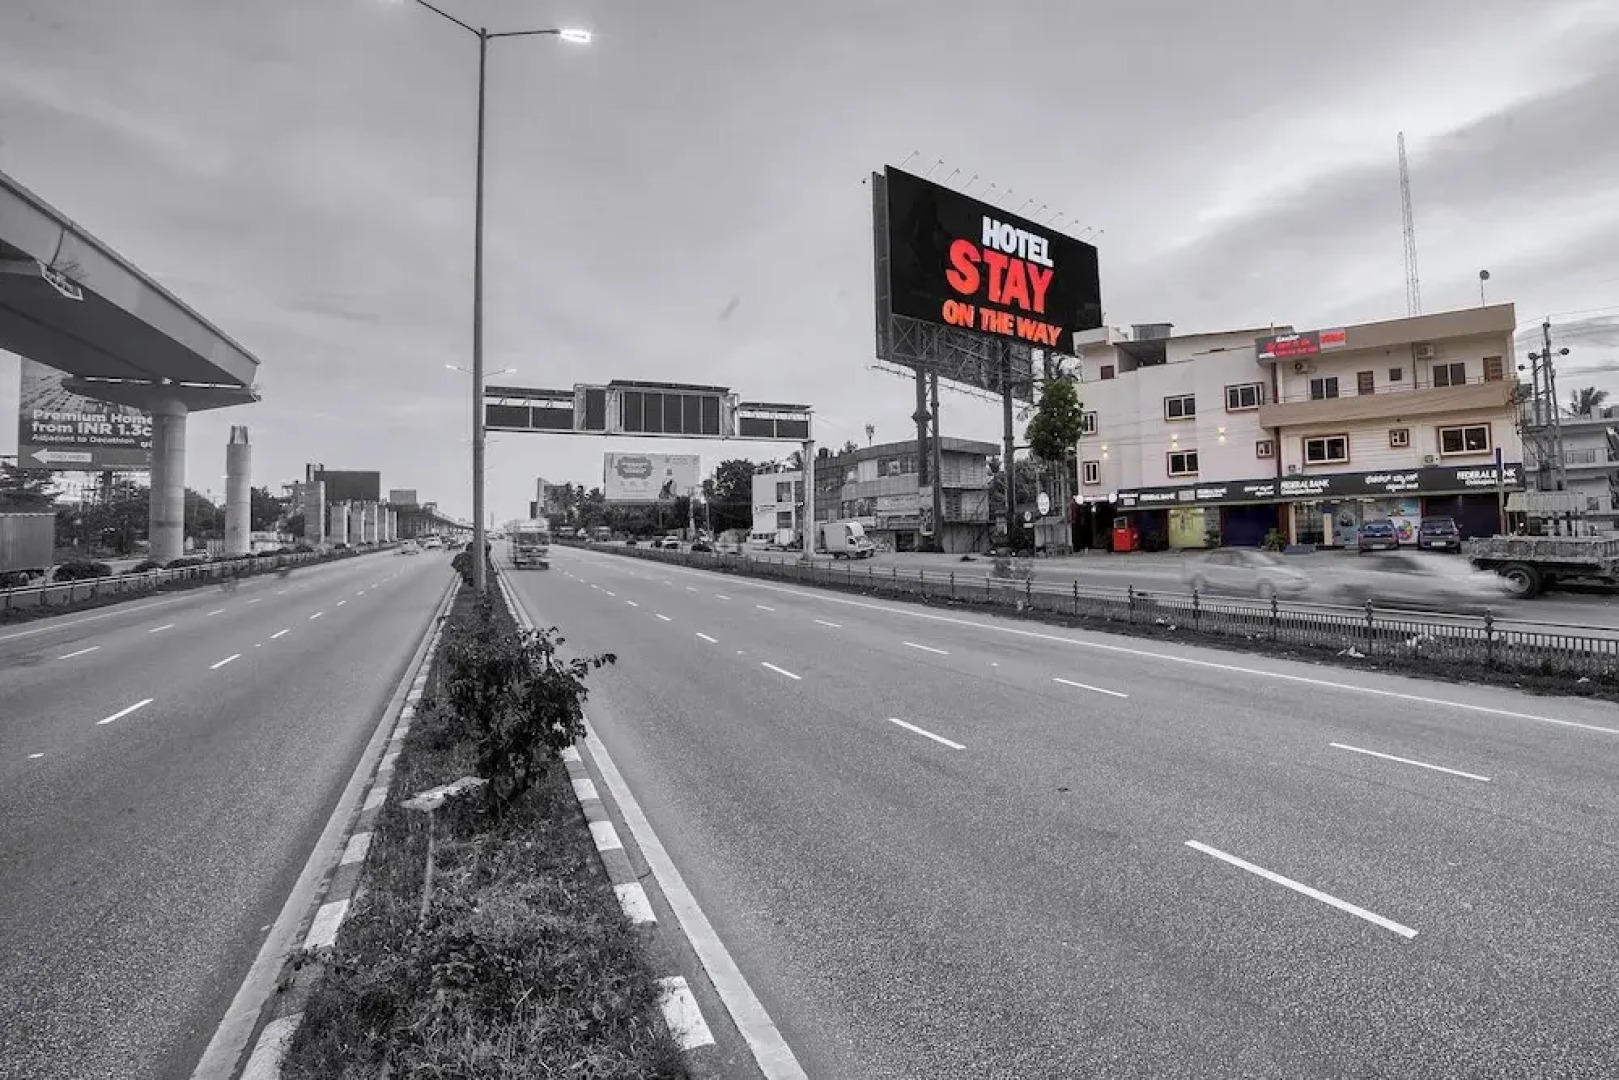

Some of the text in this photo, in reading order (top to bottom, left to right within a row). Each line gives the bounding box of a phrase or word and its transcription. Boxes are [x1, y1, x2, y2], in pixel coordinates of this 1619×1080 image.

[982, 215, 1053, 268] HOTEL
[945, 239, 1054, 314] STAY
[943, 299, 1063, 347] ON THE WAY
[32, 420, 74, 433] from
[77, 422, 113, 435] INR
[33, 409, 107, 422] Premium
[32, 434, 75, 443] Adjacent
[89, 436, 135, 444] Decathlon
